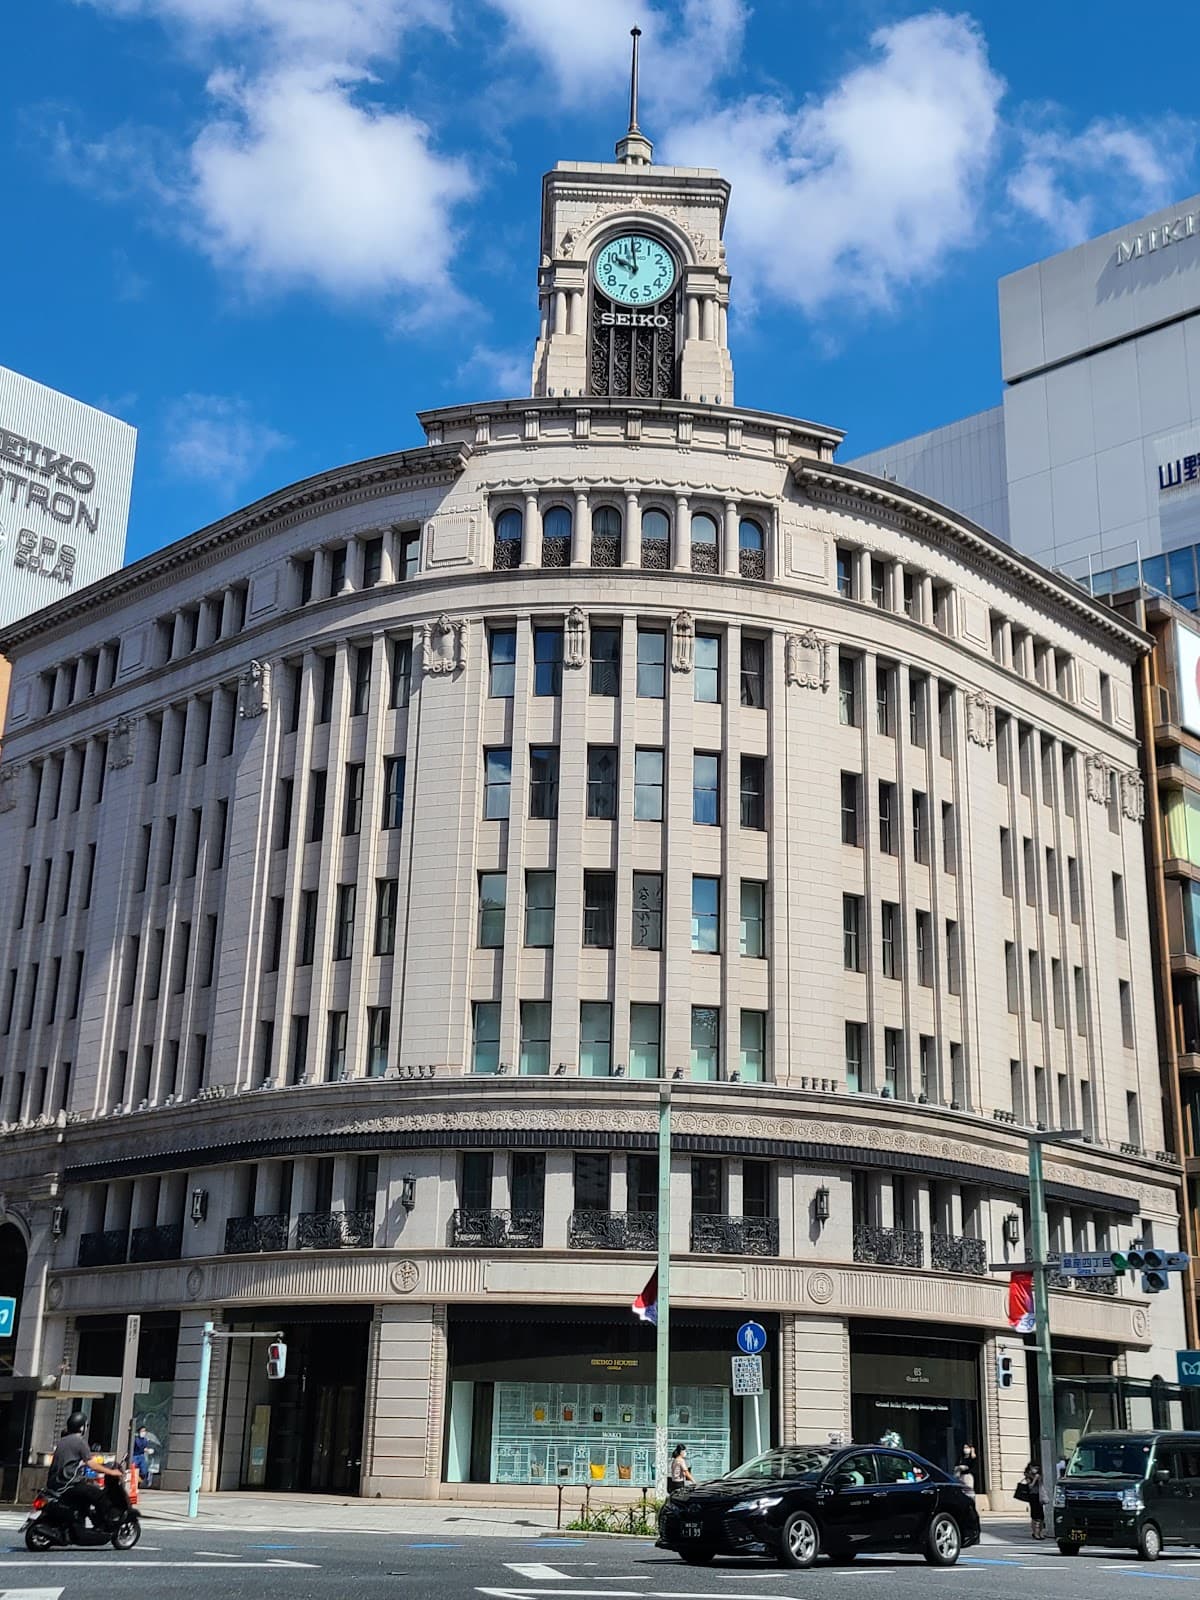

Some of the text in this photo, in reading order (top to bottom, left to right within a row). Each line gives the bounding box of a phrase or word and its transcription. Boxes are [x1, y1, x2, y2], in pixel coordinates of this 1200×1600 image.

[1116, 209, 1200, 267] MIKI
[619, 244, 627, 255] 11
[647, 245, 651, 256] 1
[607, 252, 618, 263] 10
[654, 254, 663, 265] 2
[603, 264, 612, 275] 9
[659, 266, 668, 278] 3
[607, 275, 617, 287] 8
[653, 277, 663, 289] 4
[618, 284, 628, 295] 7
[629, 288, 639, 299] 6
[643, 285, 652, 297] 5
[601, 312, 669, 328] SEIKO
[0, 428, 96, 493] EIKO
[14, 550, 74, 586] SOLAR
